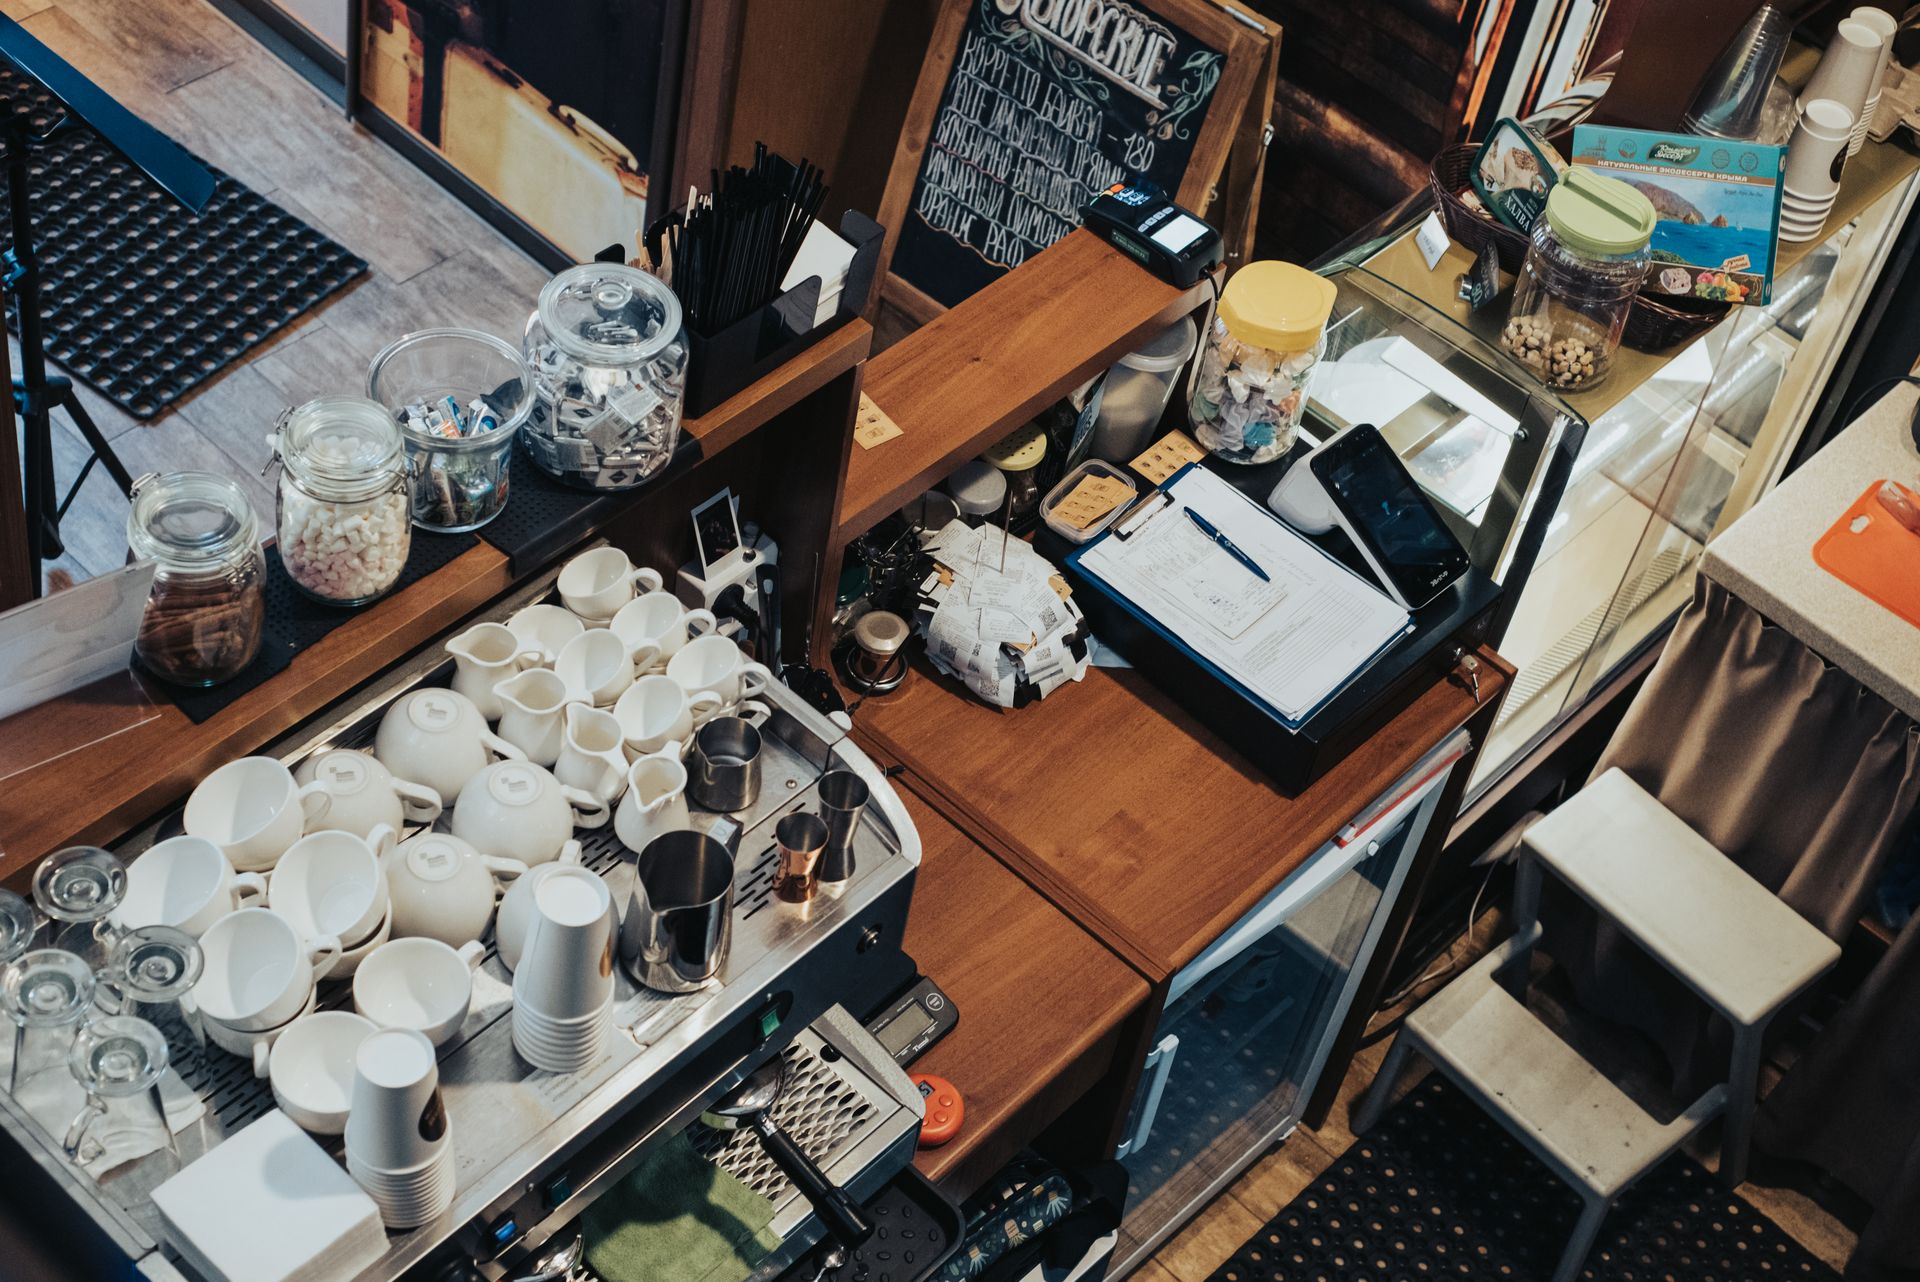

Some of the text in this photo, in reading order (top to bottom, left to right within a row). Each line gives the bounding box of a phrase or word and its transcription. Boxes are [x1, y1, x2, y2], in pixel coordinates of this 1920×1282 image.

[1040, 81, 1103, 148] БАЙКАЛ
[1124, 132, 1155, 173] 180
[1597, 159, 1749, 183] НАТУРАЛЬНЫЕ ЭКОДЕСЕРТЫ КРЫМА
[1504, 195, 1532, 232] ХАЛВА
